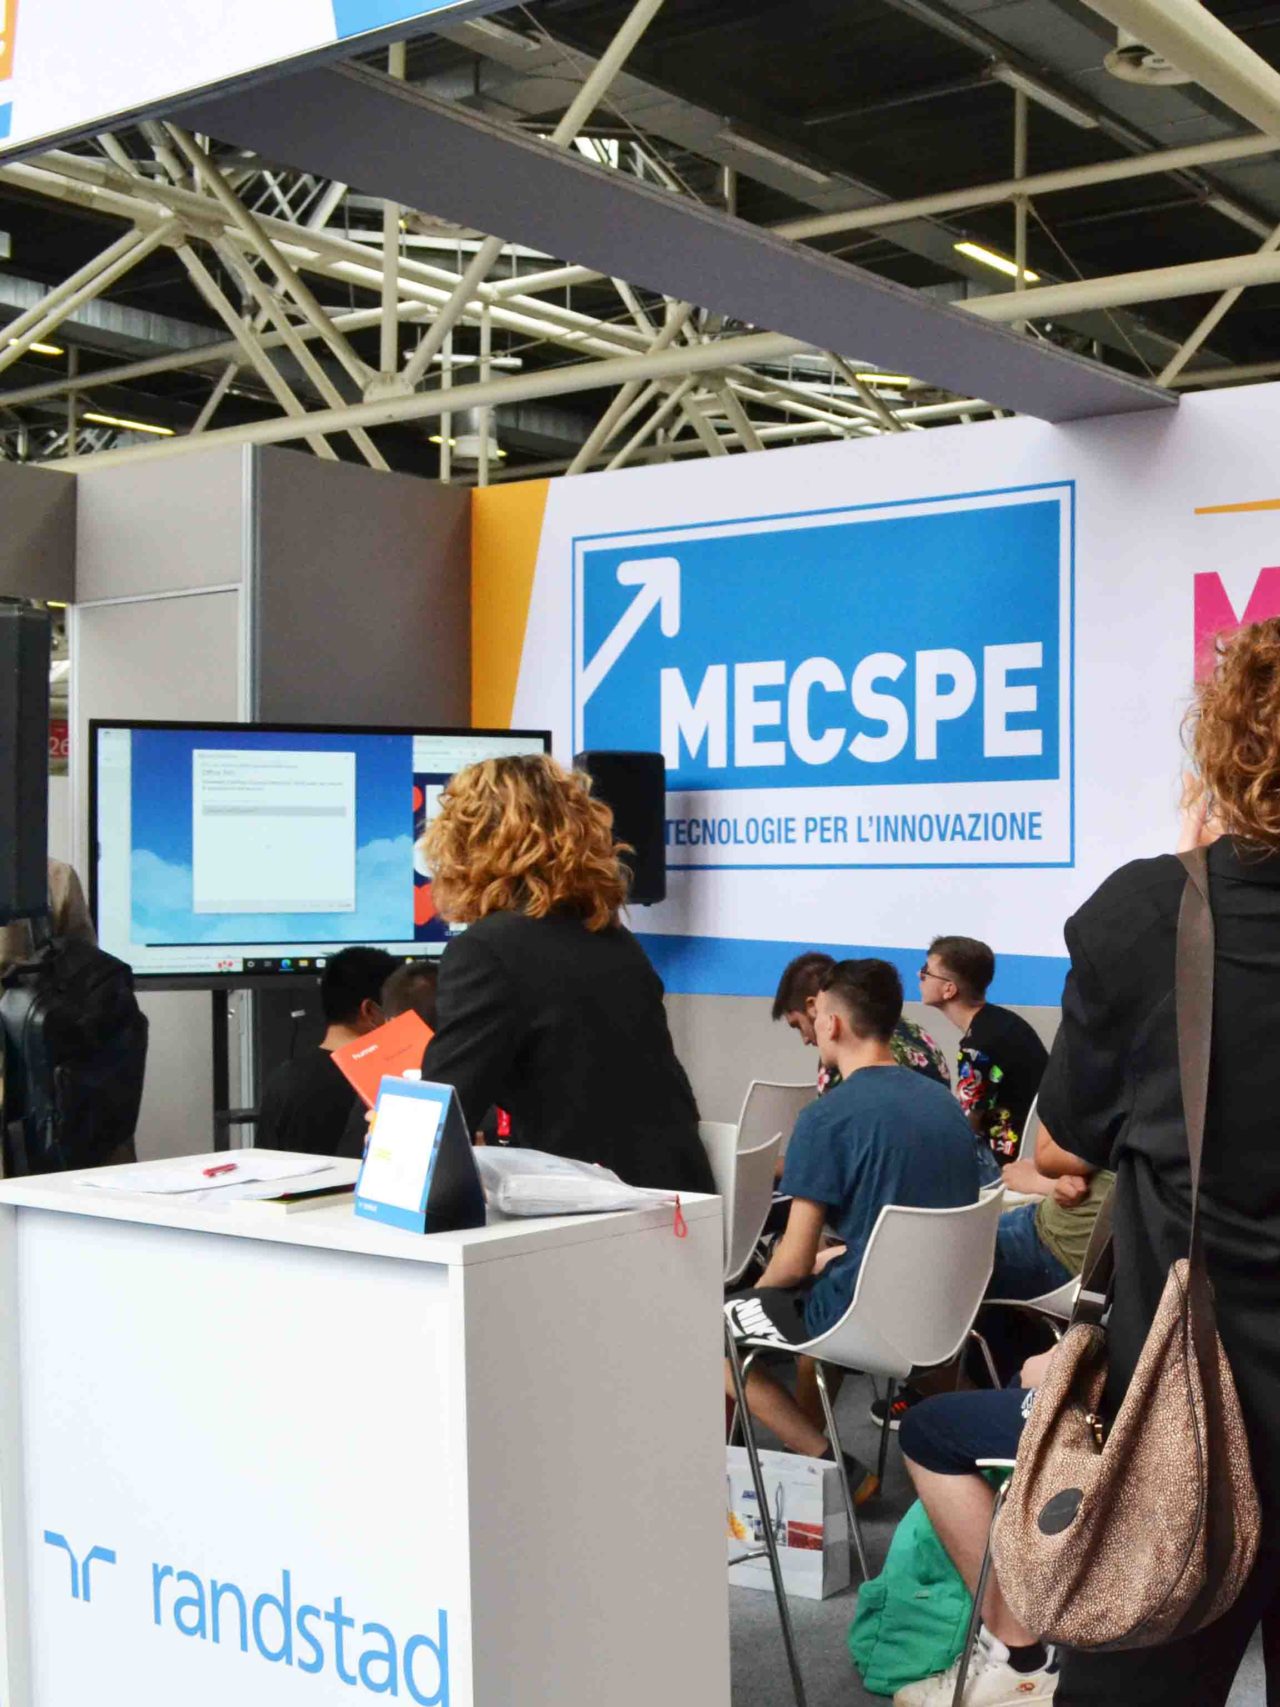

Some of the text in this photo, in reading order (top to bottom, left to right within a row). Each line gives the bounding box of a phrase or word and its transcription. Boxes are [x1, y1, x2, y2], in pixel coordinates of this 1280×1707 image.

[660, 641, 1044, 770] MECSPE
[664, 812, 1042, 846] TECNOLOGIE PER L'INNOVAZIONE
[152, 1562, 450, 1707] randstad
